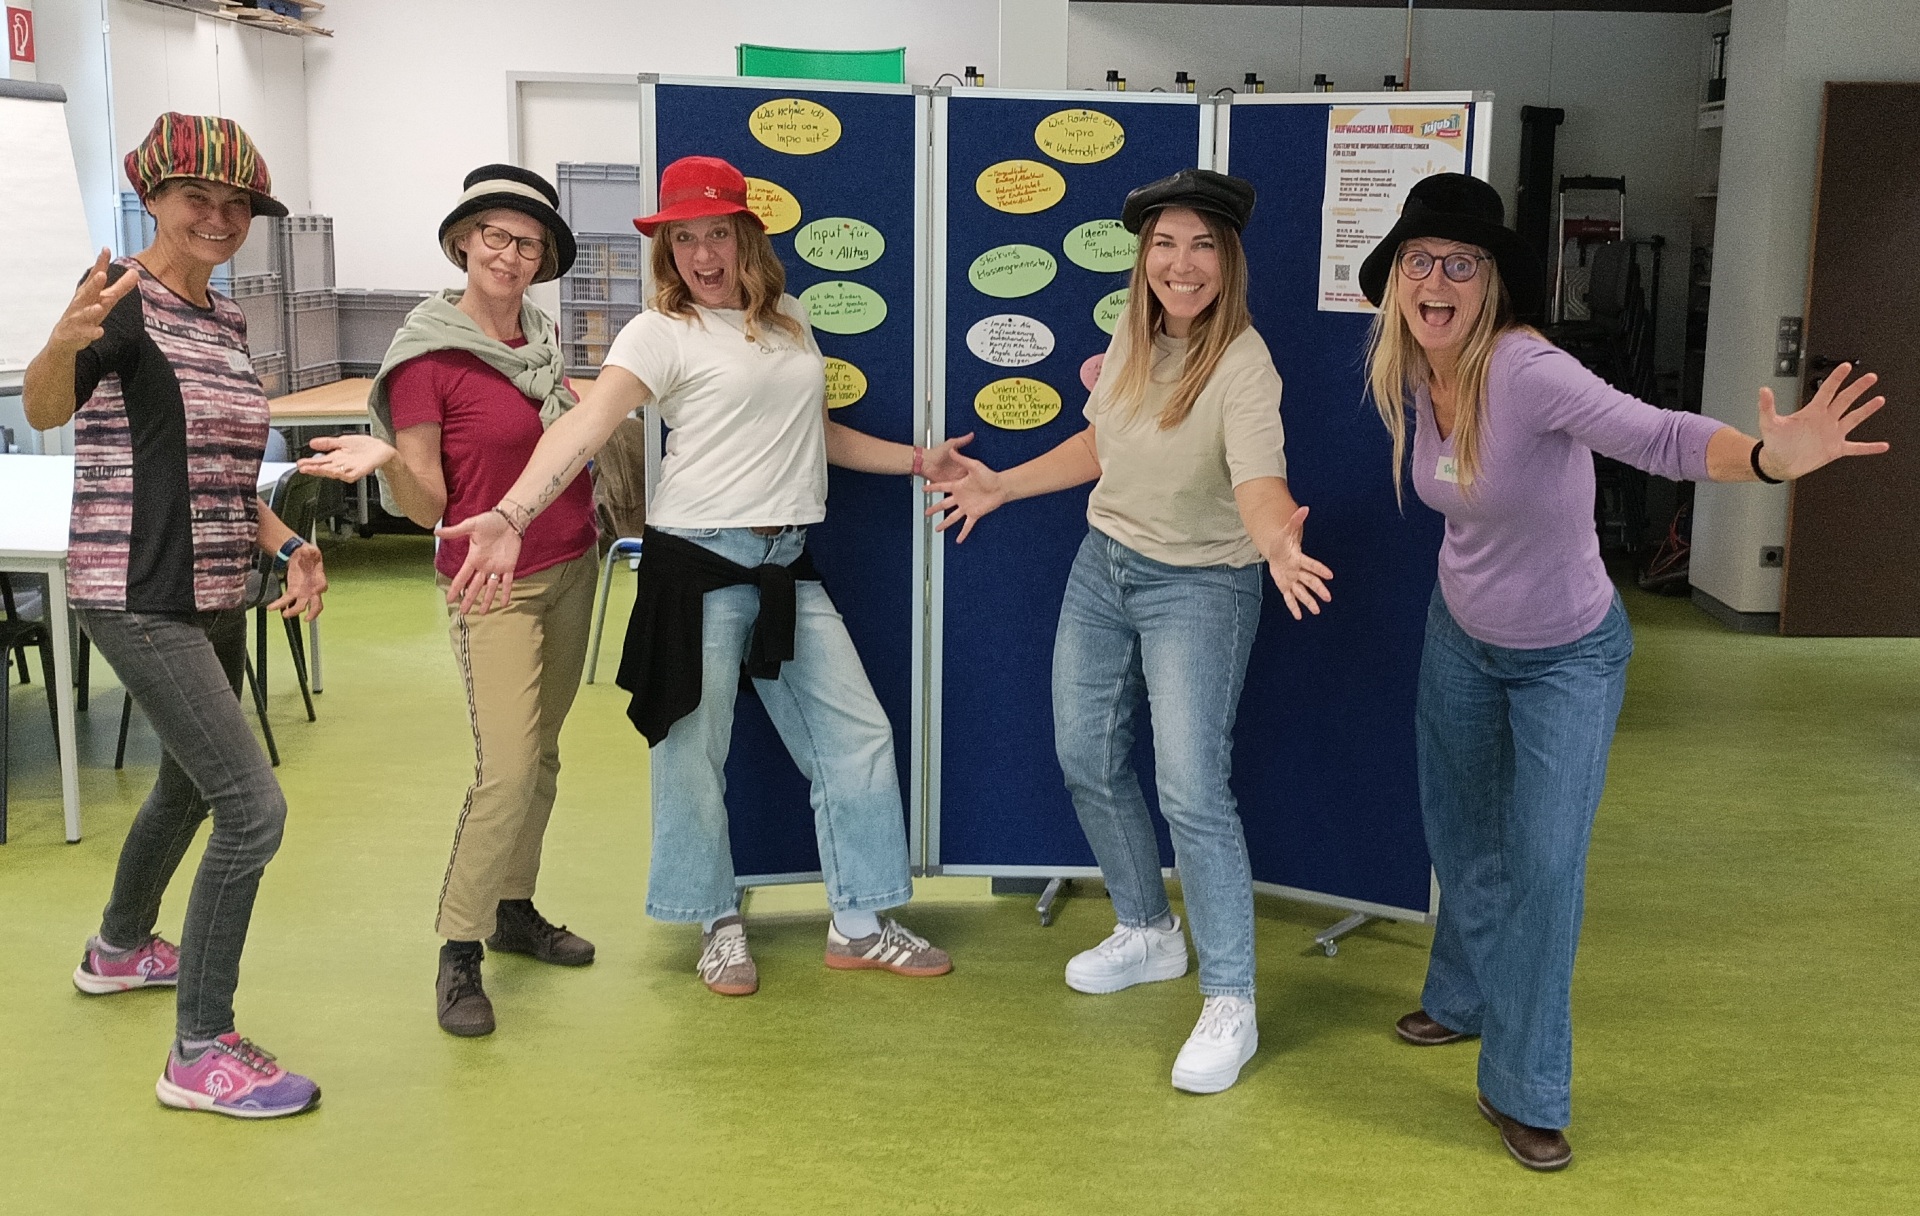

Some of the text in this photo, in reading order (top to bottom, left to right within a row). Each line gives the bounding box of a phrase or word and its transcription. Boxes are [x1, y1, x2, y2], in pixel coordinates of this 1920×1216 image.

[757, 104, 824, 120] Was nehme ich
[759, 122, 773, 134] für
[777, 121, 797, 131] mich
[1047, 118, 1064, 128] Wie
[1103, 118, 1115, 129] ich
[1334, 124, 1414, 134] AUFWACHSEN MIT MEDIEN
[777, 133, 801, 148] Impro
[1065, 128, 1094, 142] Impro
[1044, 139, 1052, 149] im
[1057, 143, 1099, 157] Unterricht
[810, 224, 869, 244] Input für
[1081, 228, 1108, 239] Ideen
[1084, 239, 1096, 250] für
[1092, 243, 1136, 258] Theaterstü
[807, 246, 823, 258] AG
[836, 246, 869, 260] Alltag
[979, 249, 1020, 266] Stärkung
[997, 402, 1015, 410] auch
